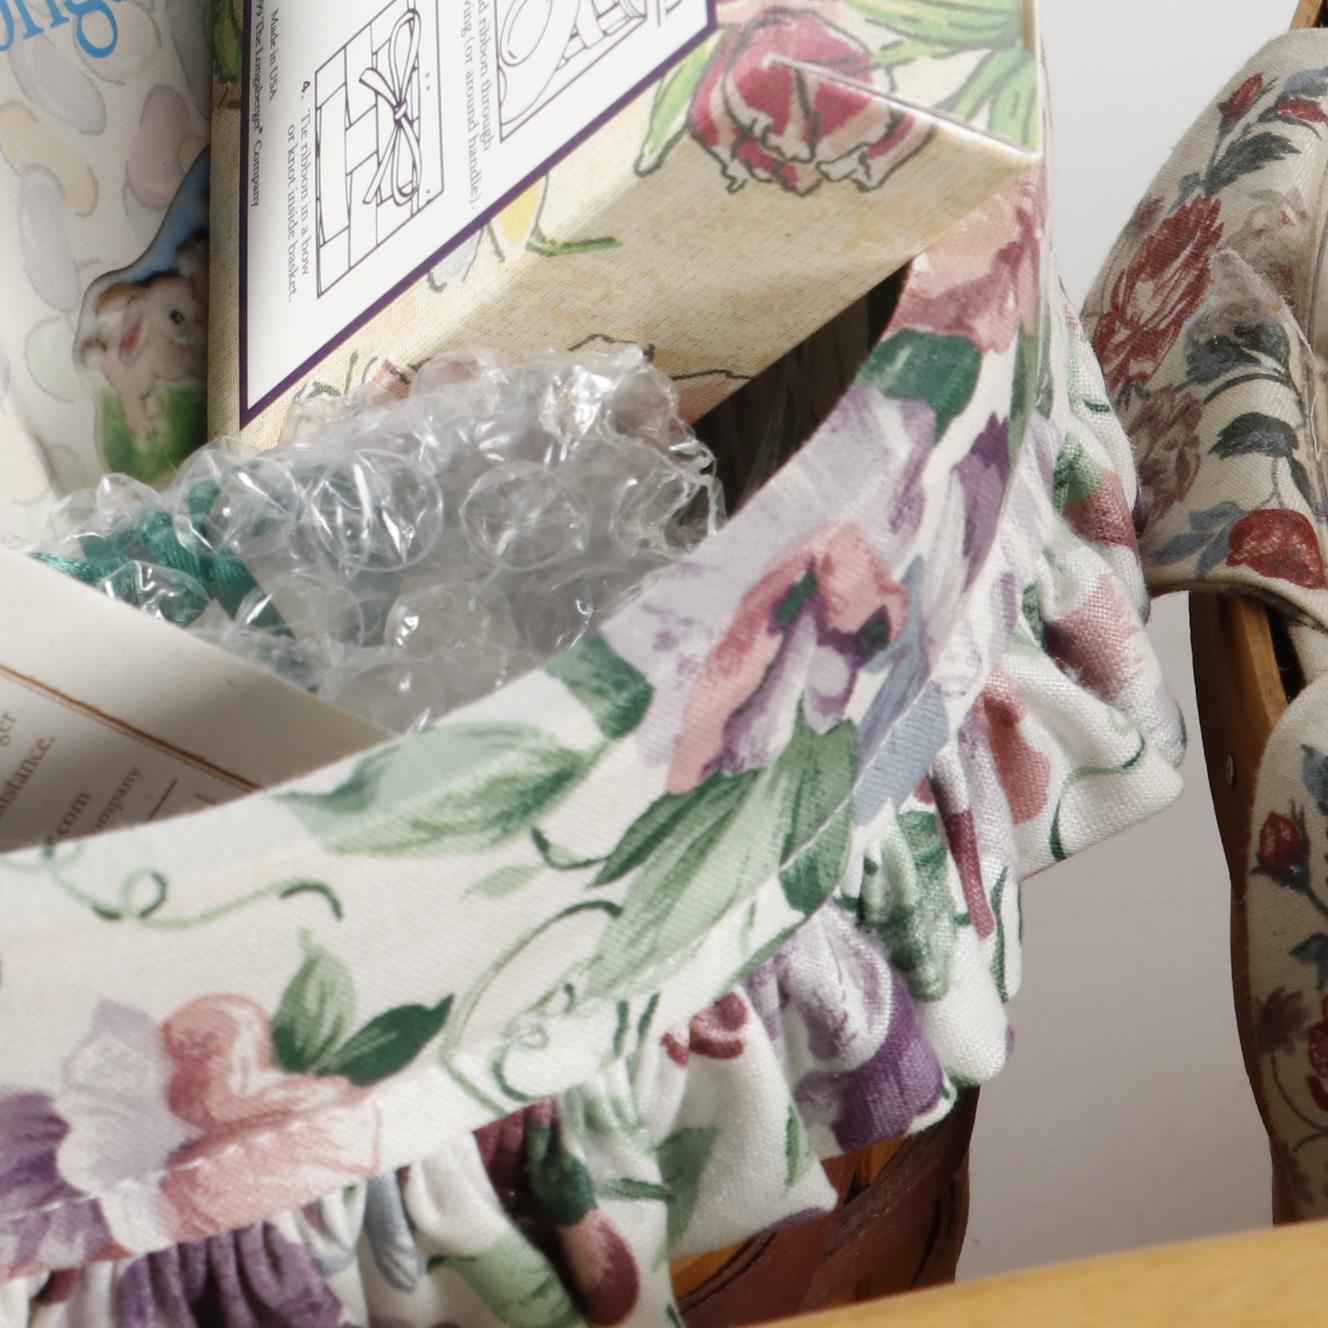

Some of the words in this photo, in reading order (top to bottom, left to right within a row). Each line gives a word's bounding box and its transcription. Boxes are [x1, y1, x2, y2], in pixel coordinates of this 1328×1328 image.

[255, 18, 266, 47] The
[269, 8, 280, 49] Made
[478, 17, 492, 76] ribbon
[269, 51, 279, 67] in
[463, 35, 478, 65] (or
[269, 67, 279, 102] USA
[299, 80, 312, 100] 4.
[465, 69, 479, 131] around
[298, 108, 312, 138] Tie
[479, 77, 496, 153] through
[287, 124, 297, 146] or
[250, 139, 263, 209] Company
[286, 147, 299, 187] knot
[298, 142, 311, 200] ribbon
[287, 189, 300, 241] inside
[299, 202, 310, 222] in
[299, 239, 311, 276] bow
